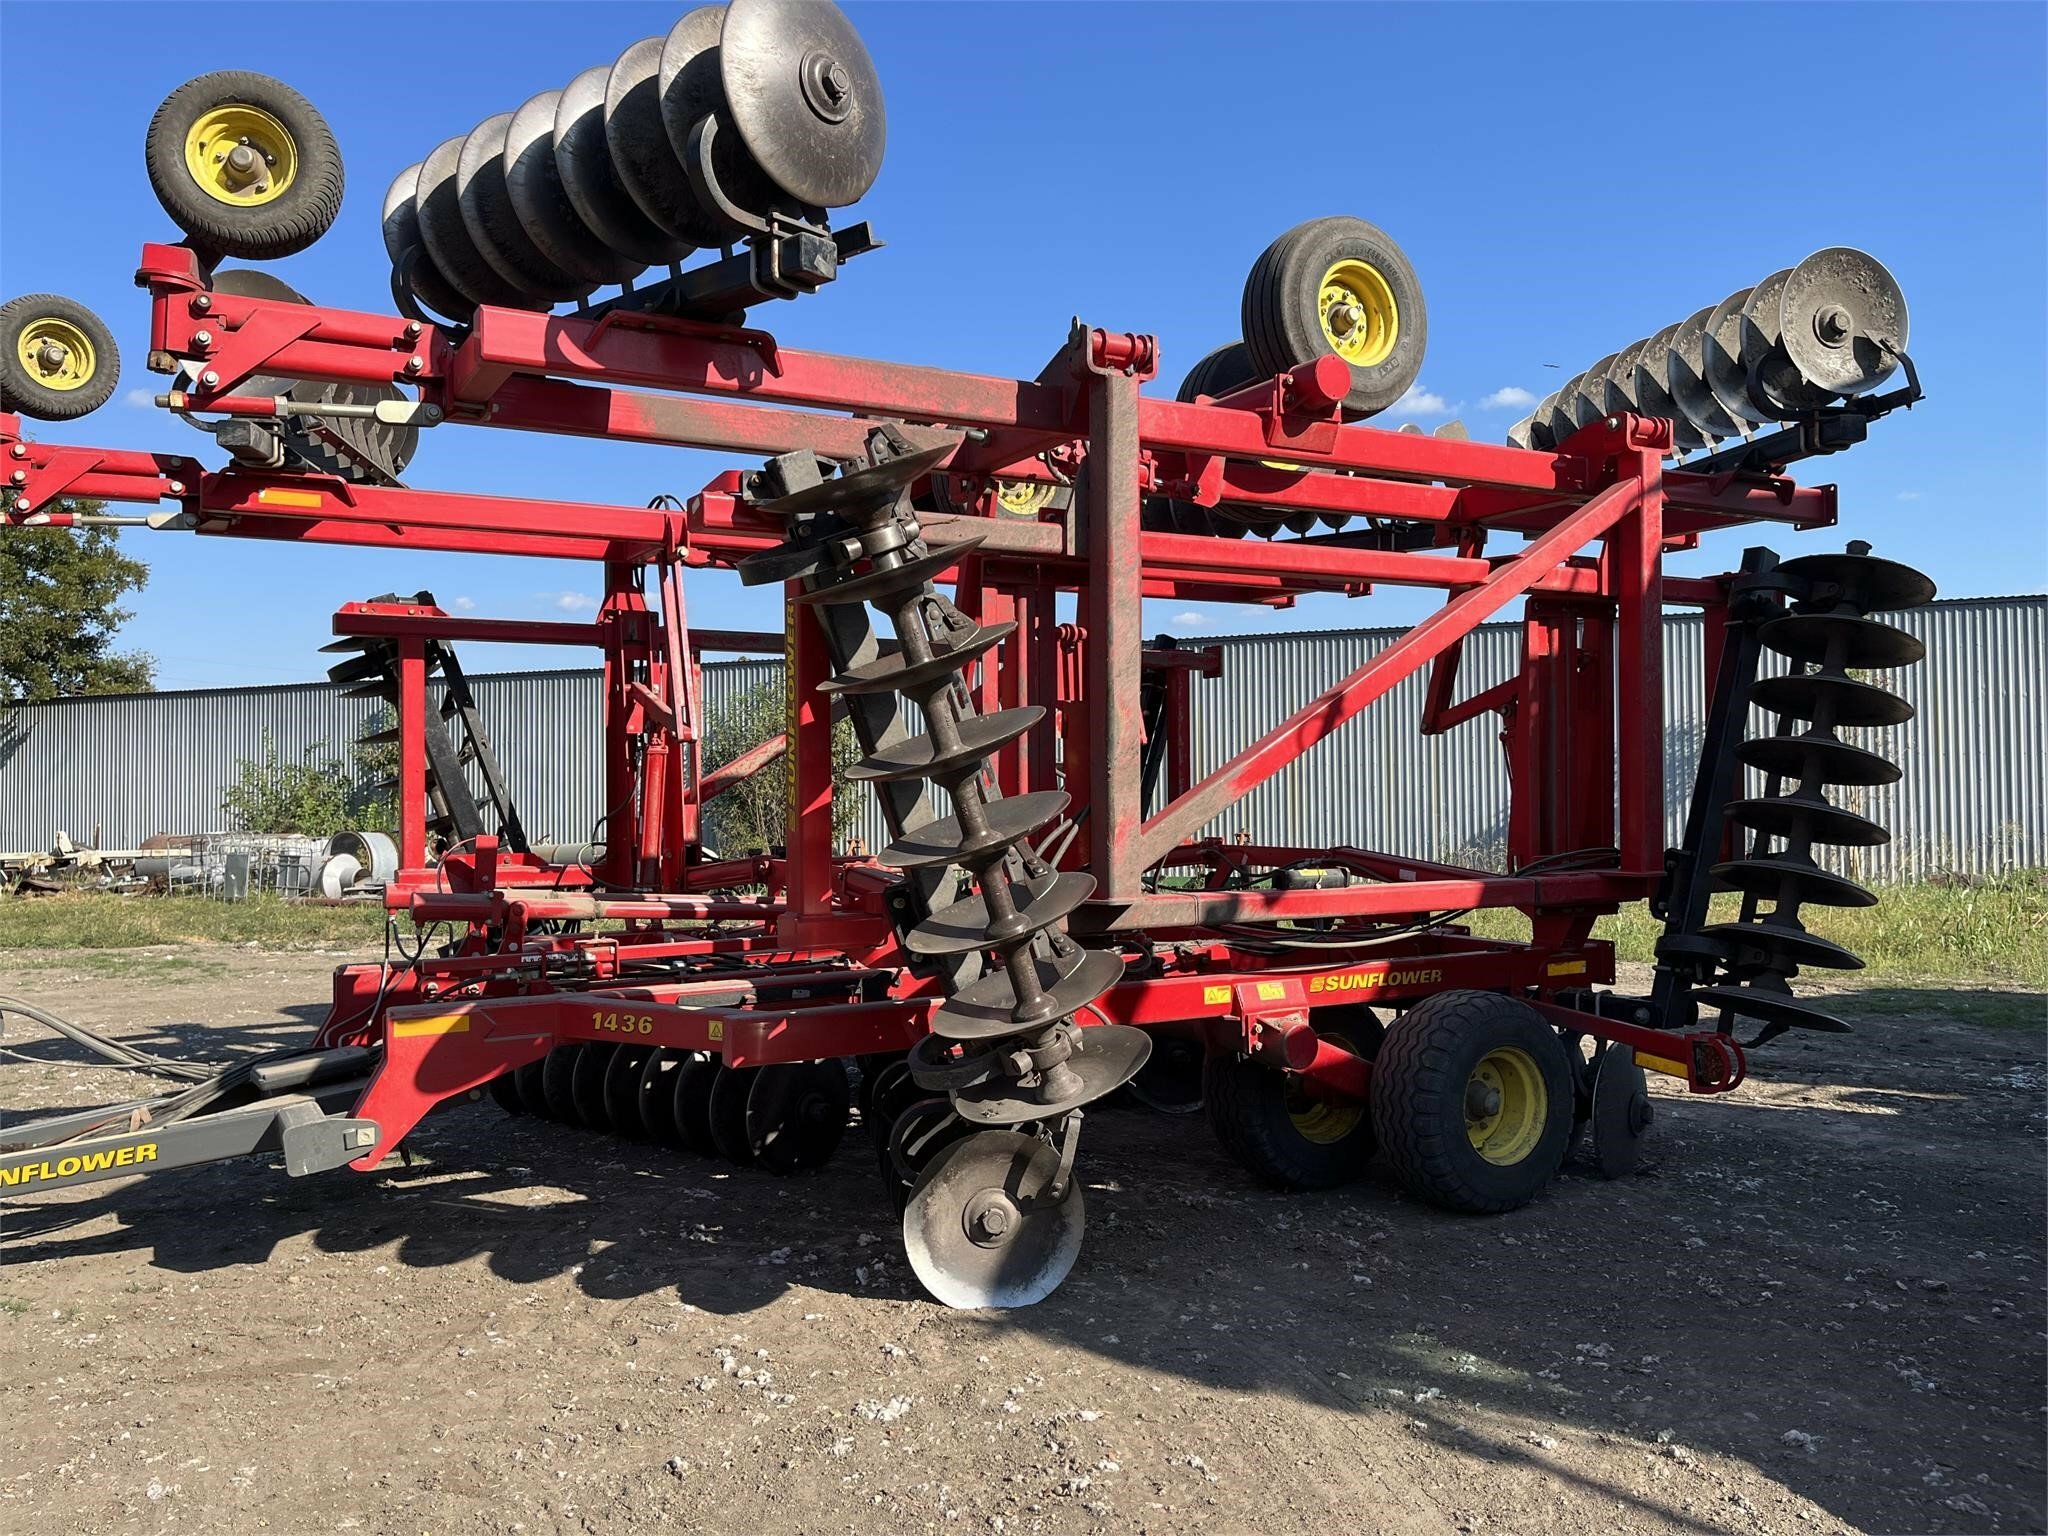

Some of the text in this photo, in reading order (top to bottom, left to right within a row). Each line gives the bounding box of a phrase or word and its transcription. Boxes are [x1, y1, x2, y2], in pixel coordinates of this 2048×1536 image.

[786, 602, 797, 806] SUNFLOWER
[1325, 969, 1443, 992] SUNFLOWER
[592, 1011, 654, 1035] 1436
